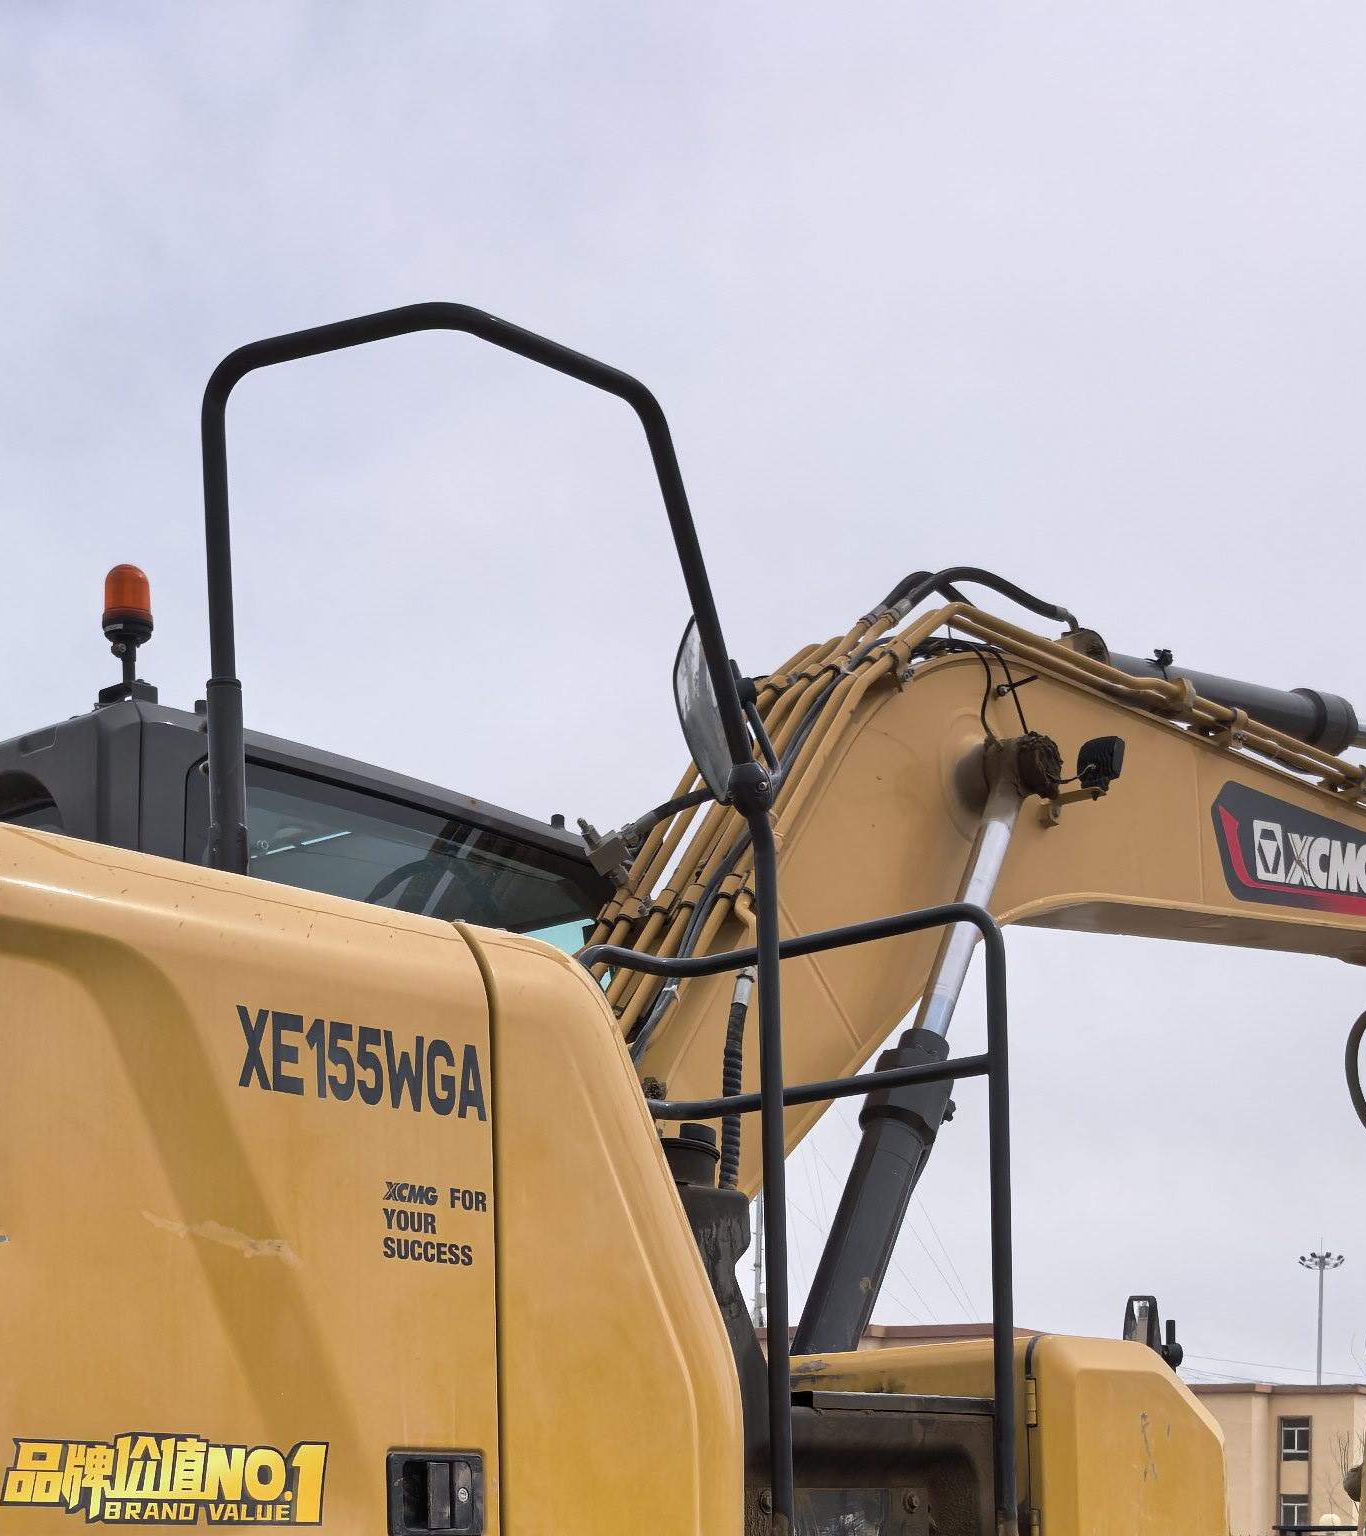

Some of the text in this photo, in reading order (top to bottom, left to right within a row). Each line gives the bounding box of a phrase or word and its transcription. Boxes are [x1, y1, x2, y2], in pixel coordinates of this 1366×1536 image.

[236, 1004, 487, 1122] XE155WGA
[382, 1181, 487, 1213] XCMG FOR
[382, 1207, 437, 1235] YOUR
[382, 1236, 473, 1266] SUCCESS
[103, 1500, 291, 1522] BRAND VALUE
